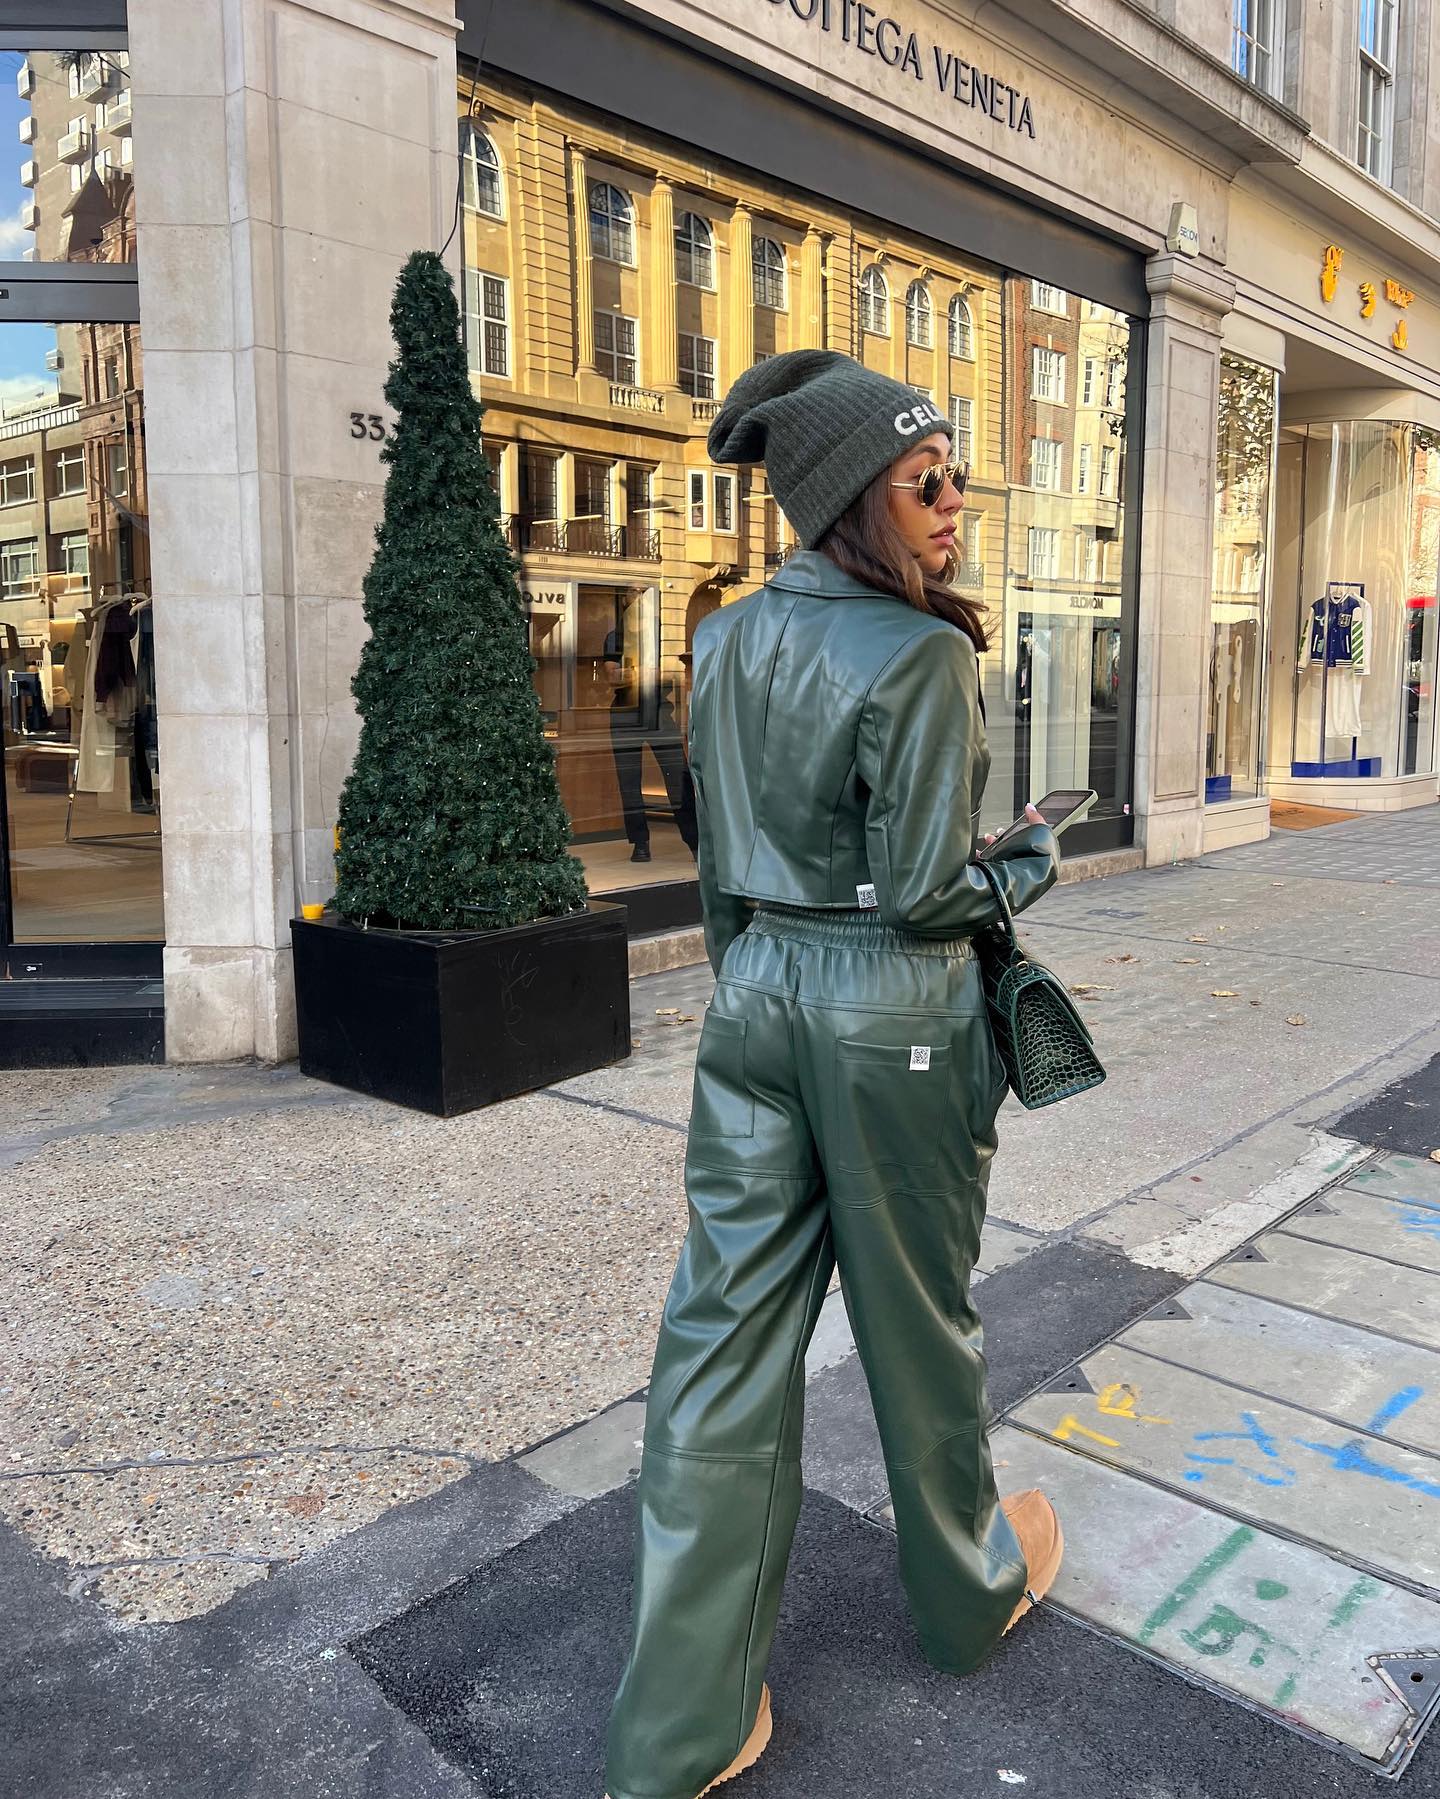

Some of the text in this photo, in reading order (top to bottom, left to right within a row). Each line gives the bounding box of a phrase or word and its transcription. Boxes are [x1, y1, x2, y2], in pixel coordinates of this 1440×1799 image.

[767, 0, 1036, 139] TTEGA VENETA
[350, 412, 386, 441] 33
